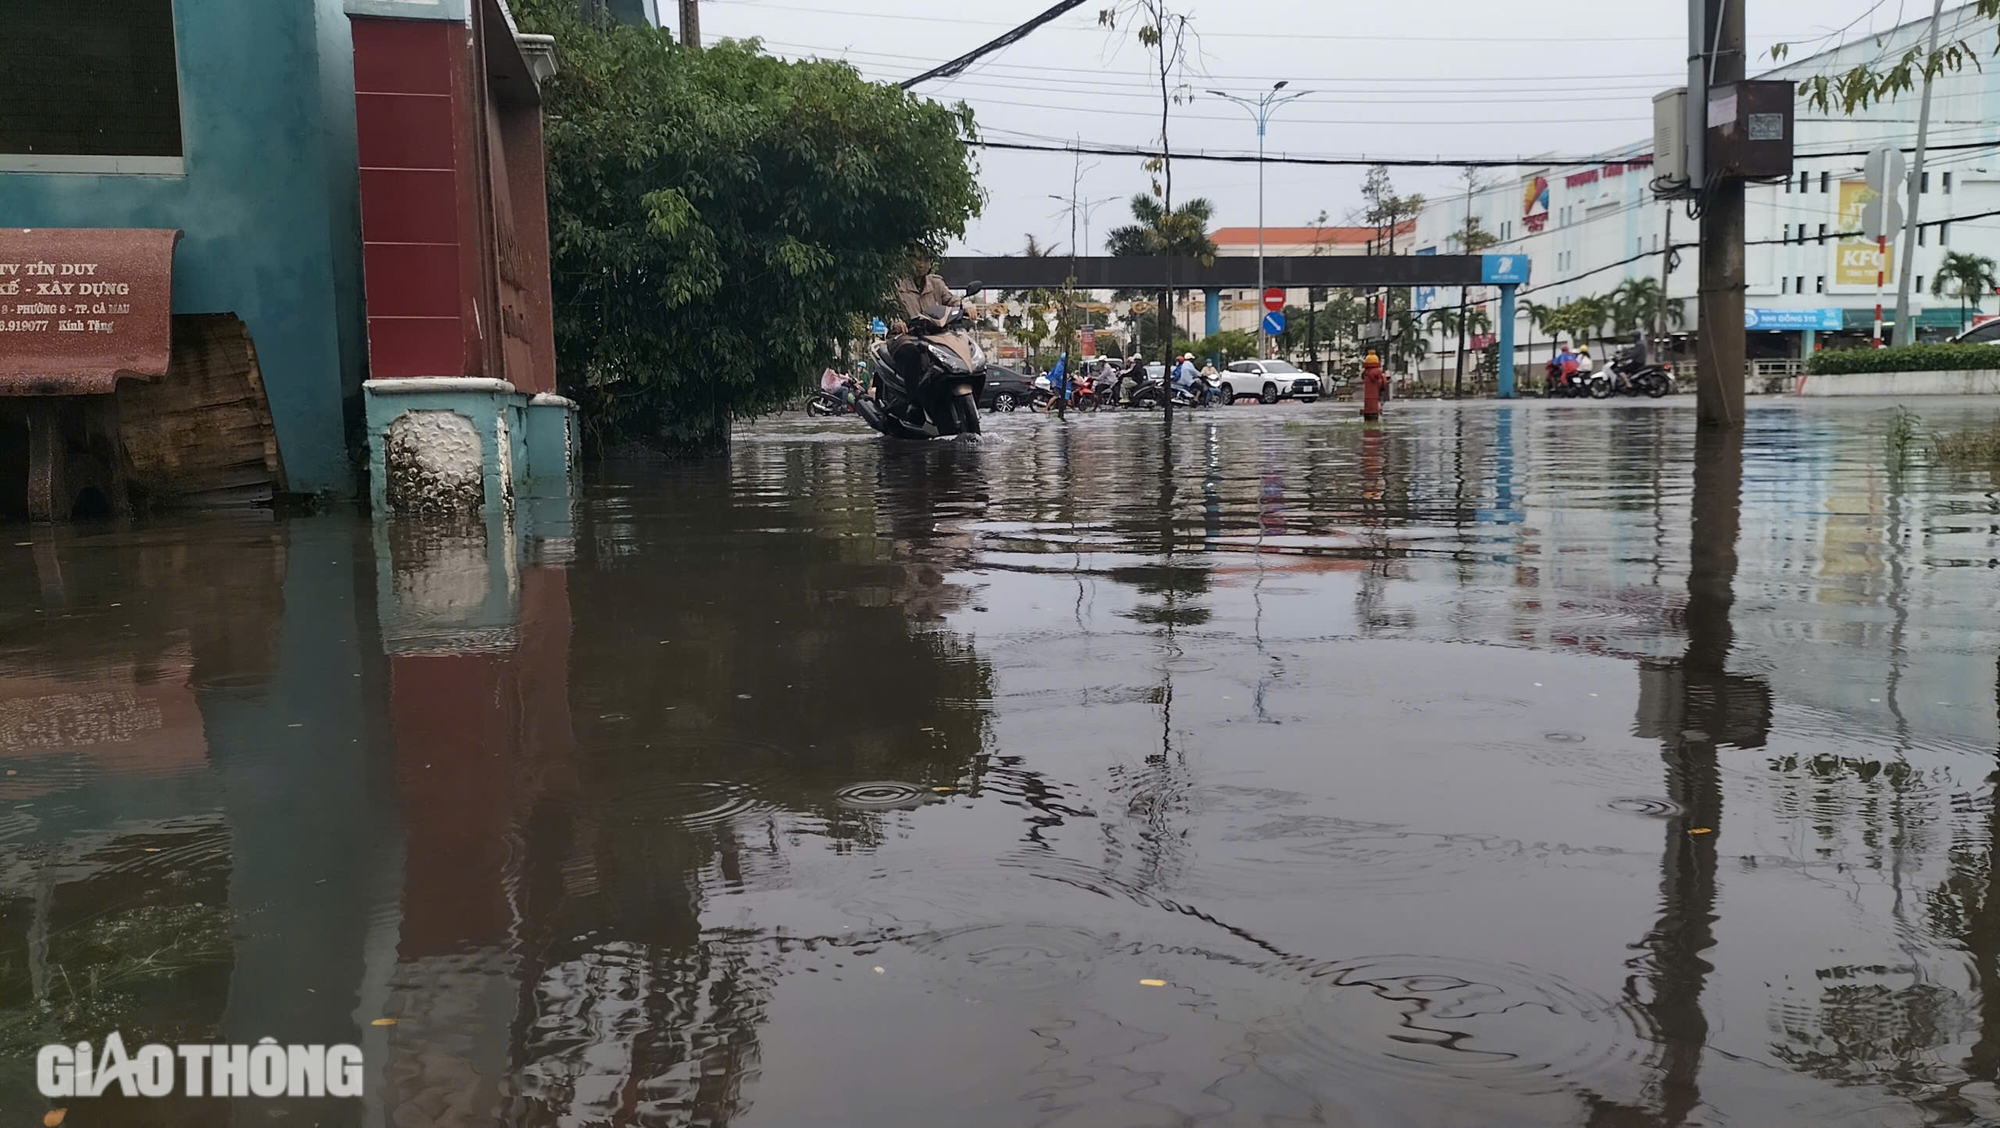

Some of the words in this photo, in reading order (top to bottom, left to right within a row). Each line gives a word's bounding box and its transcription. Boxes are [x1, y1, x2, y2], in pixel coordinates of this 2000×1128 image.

[25, 260, 56, 275] TÍN
[60, 264, 98, 275] DUY
[36, 281, 75, 295] XÂY
[79, 282, 129, 298] DỰNG
[17, 302, 57, 314] PHƯỜNG
[75, 305, 90, 314] TP.
[92, 302, 106, 314] CÀ
[108, 304, 130, 314] MAU
[58, 320, 84, 331] Kính
[87, 320, 114, 334] Tặng
